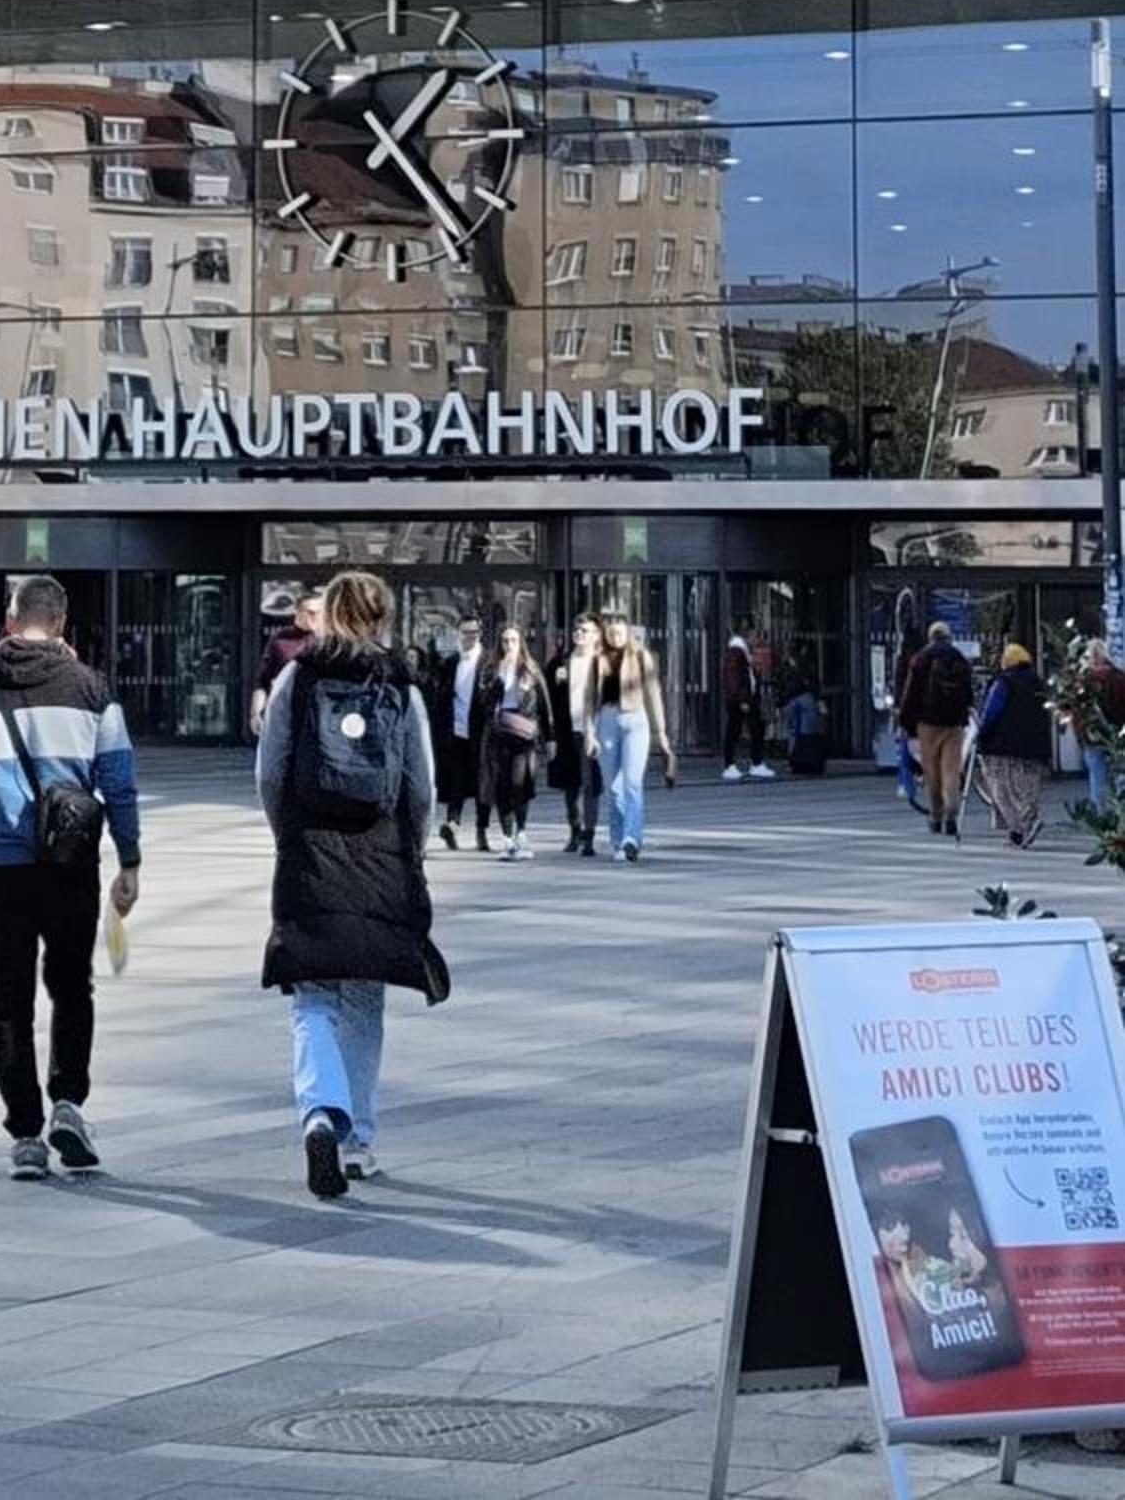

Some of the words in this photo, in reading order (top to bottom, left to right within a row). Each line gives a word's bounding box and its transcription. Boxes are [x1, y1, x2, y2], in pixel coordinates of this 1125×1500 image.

[132, 388, 764, 458] HAUPTBAHNHOF
[852, 1019, 953, 1054] WERDE
[956, 1016, 1020, 1049] TEIL
[1026, 1014, 1078, 1046] DES
[881, 1066, 965, 1101] AMICI
[974, 1061, 1071, 1095] CLUBS!
[930, 1312, 997, 1350] Amici!
